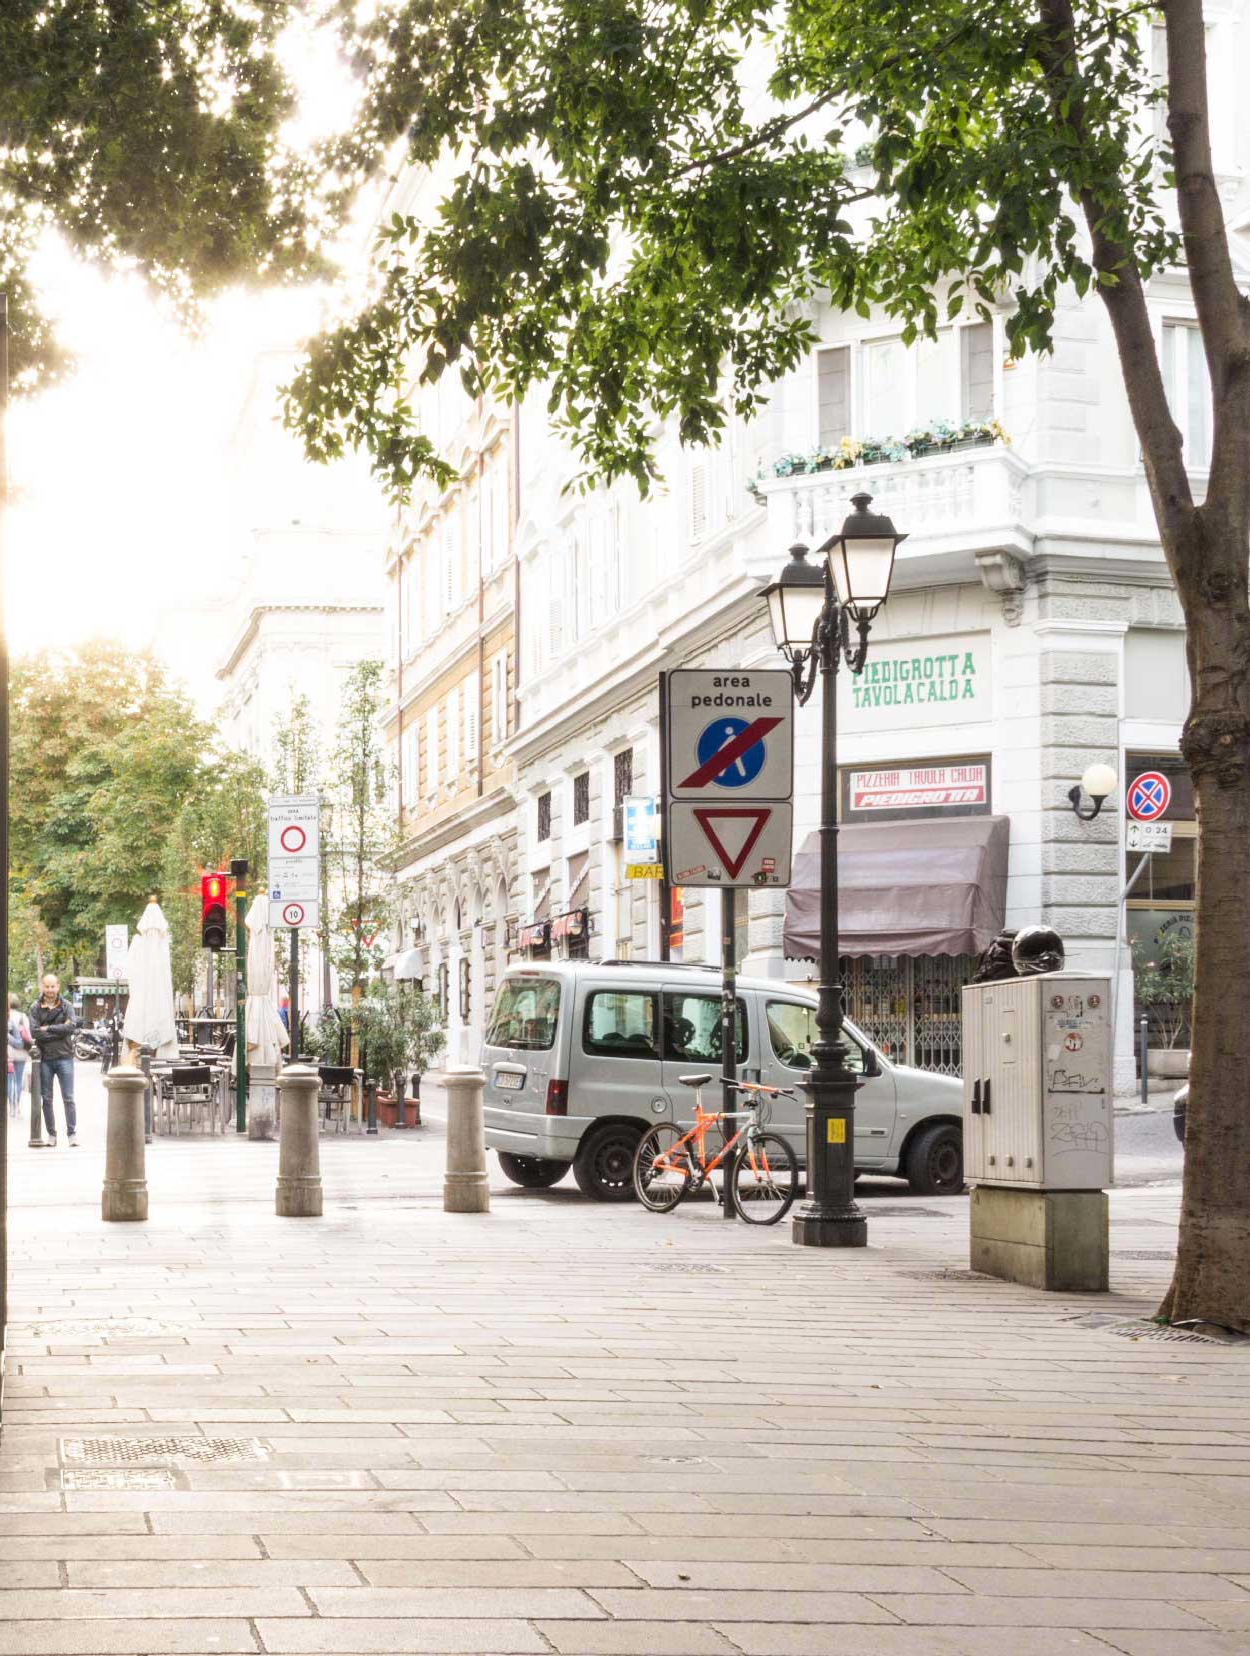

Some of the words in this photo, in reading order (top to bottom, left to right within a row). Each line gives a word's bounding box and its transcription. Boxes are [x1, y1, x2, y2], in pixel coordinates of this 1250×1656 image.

[713, 677, 750, 688] area
[691, 693, 773, 708] pedonale
[857, 772, 899, 788] PIZZERIA
[910, 768, 945, 785] TAVOLA
[950, 767, 982, 783] CALDA
[1156, 827, 1168, 835] 24
[290, 910, 298, 919] 10
